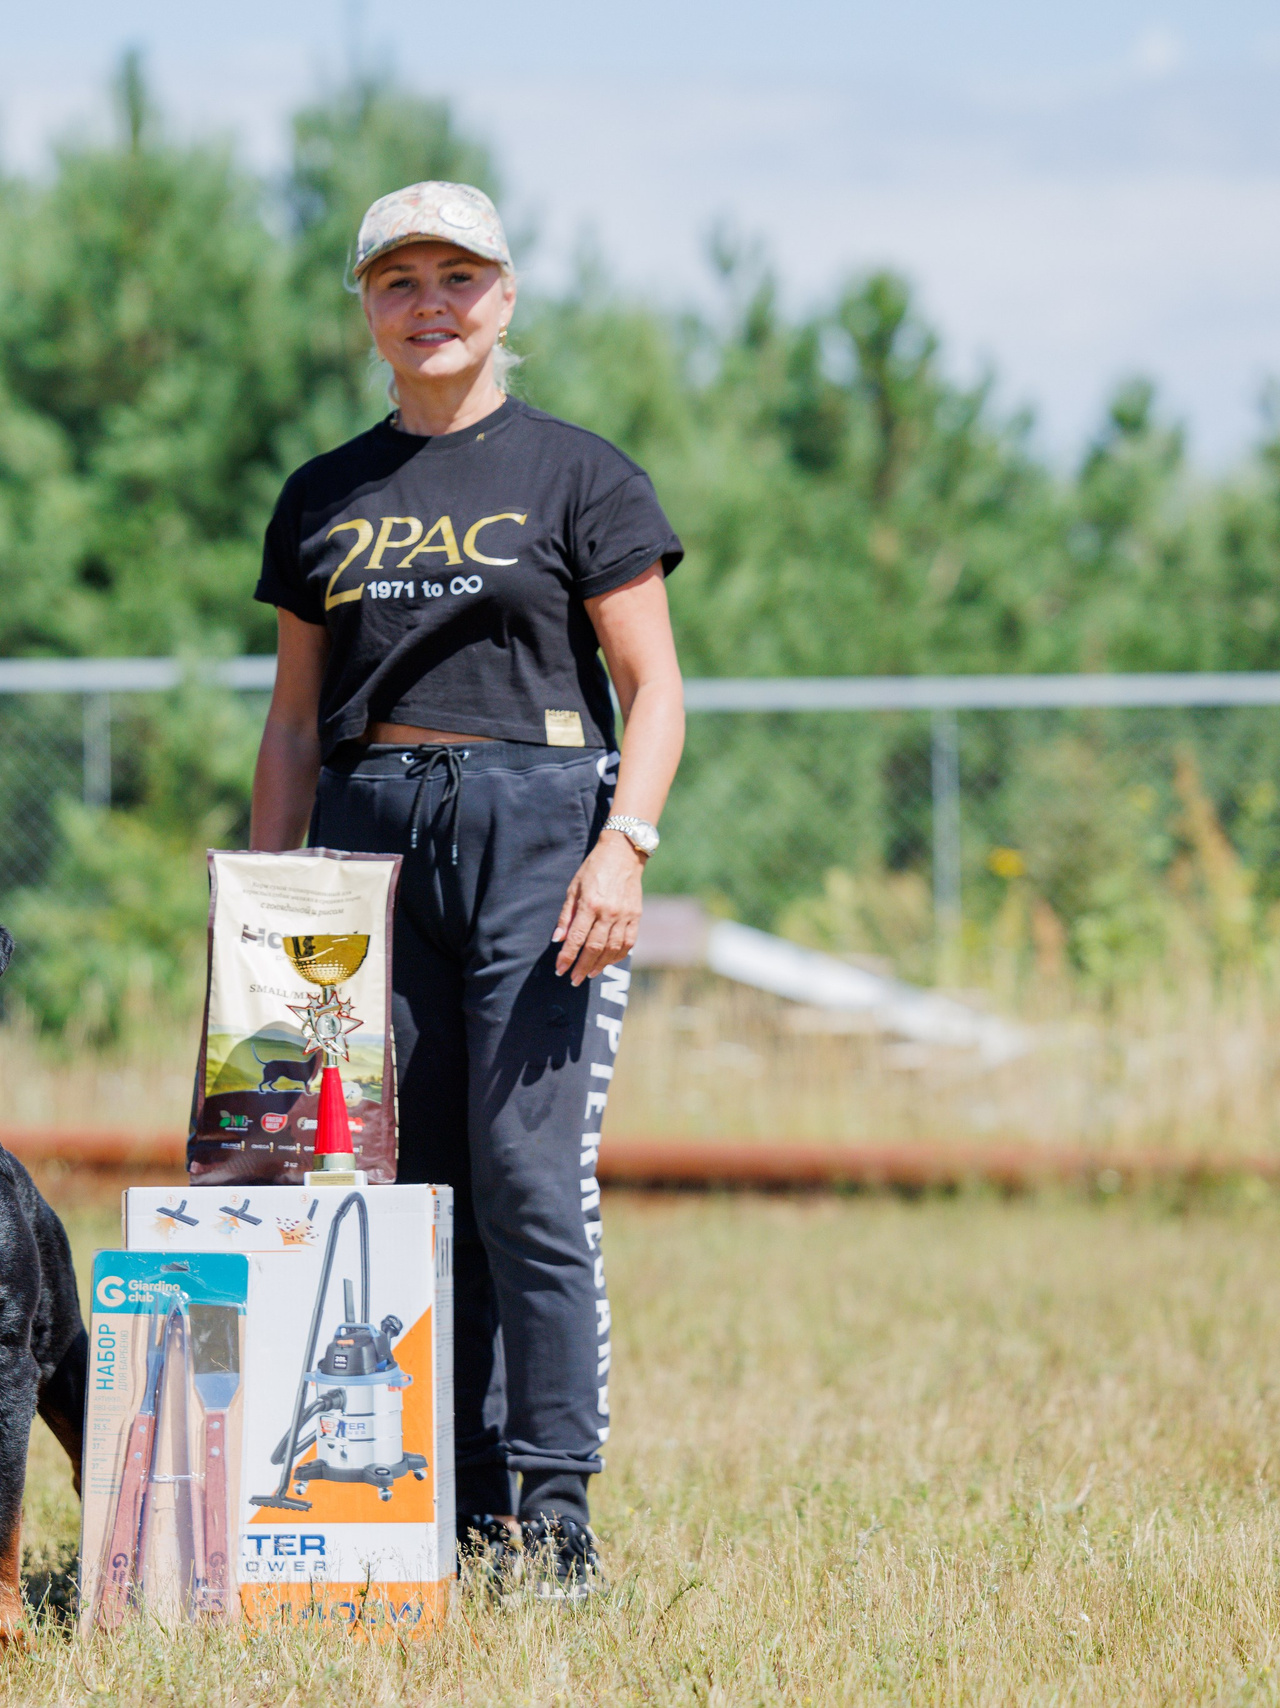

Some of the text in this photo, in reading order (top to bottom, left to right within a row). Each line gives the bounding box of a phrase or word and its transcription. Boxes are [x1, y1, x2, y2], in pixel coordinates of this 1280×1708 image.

[325, 508, 528, 612] 2PAC
[367, 580, 415, 599] 1971
[422, 580, 443, 598] to
[128, 1279, 180, 1292] Giardino
[128, 1291, 154, 1302] club
[96, 1323, 116, 1390] НАБОР
[244, 1534, 326, 1556] TER
[246, 1561, 326, 1572] OWER
